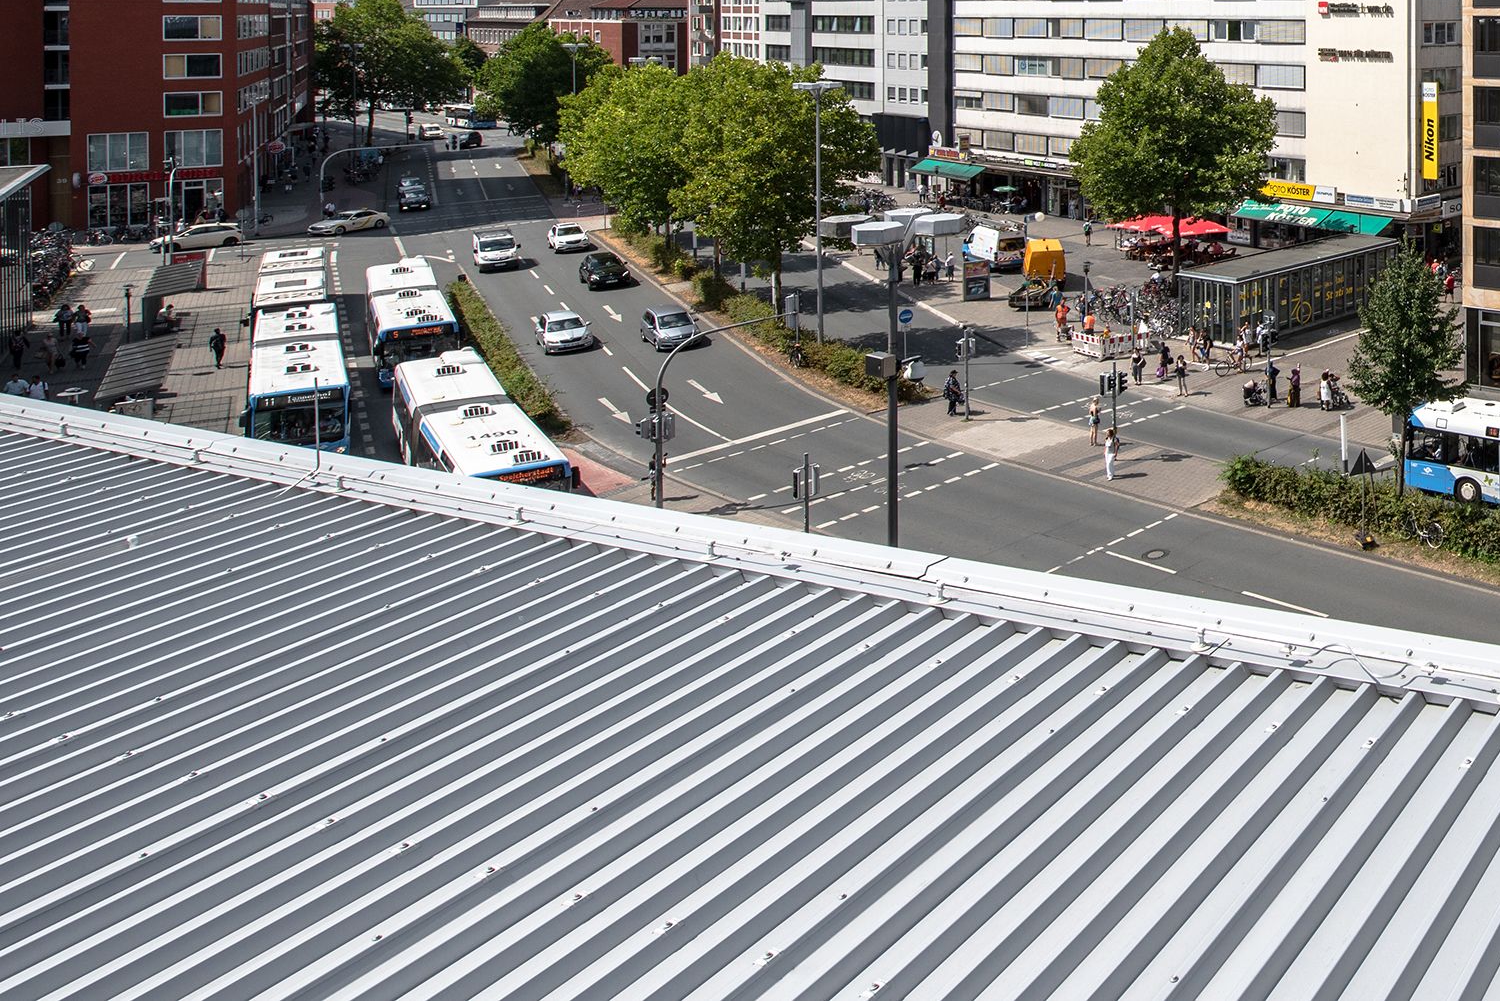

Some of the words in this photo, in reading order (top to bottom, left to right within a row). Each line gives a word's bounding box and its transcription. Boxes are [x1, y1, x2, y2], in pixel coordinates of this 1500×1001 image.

[1424, 118, 1434, 162] Nikon
[1270, 185, 1286, 194] FOTO
[1287, 185, 1310, 196] KÖSTER
[1276, 203, 1311, 215] FOTO
[1265, 211, 1318, 226] KÖSTER
[264, 397, 275, 407] 11
[467, 429, 518, 441] 1490
